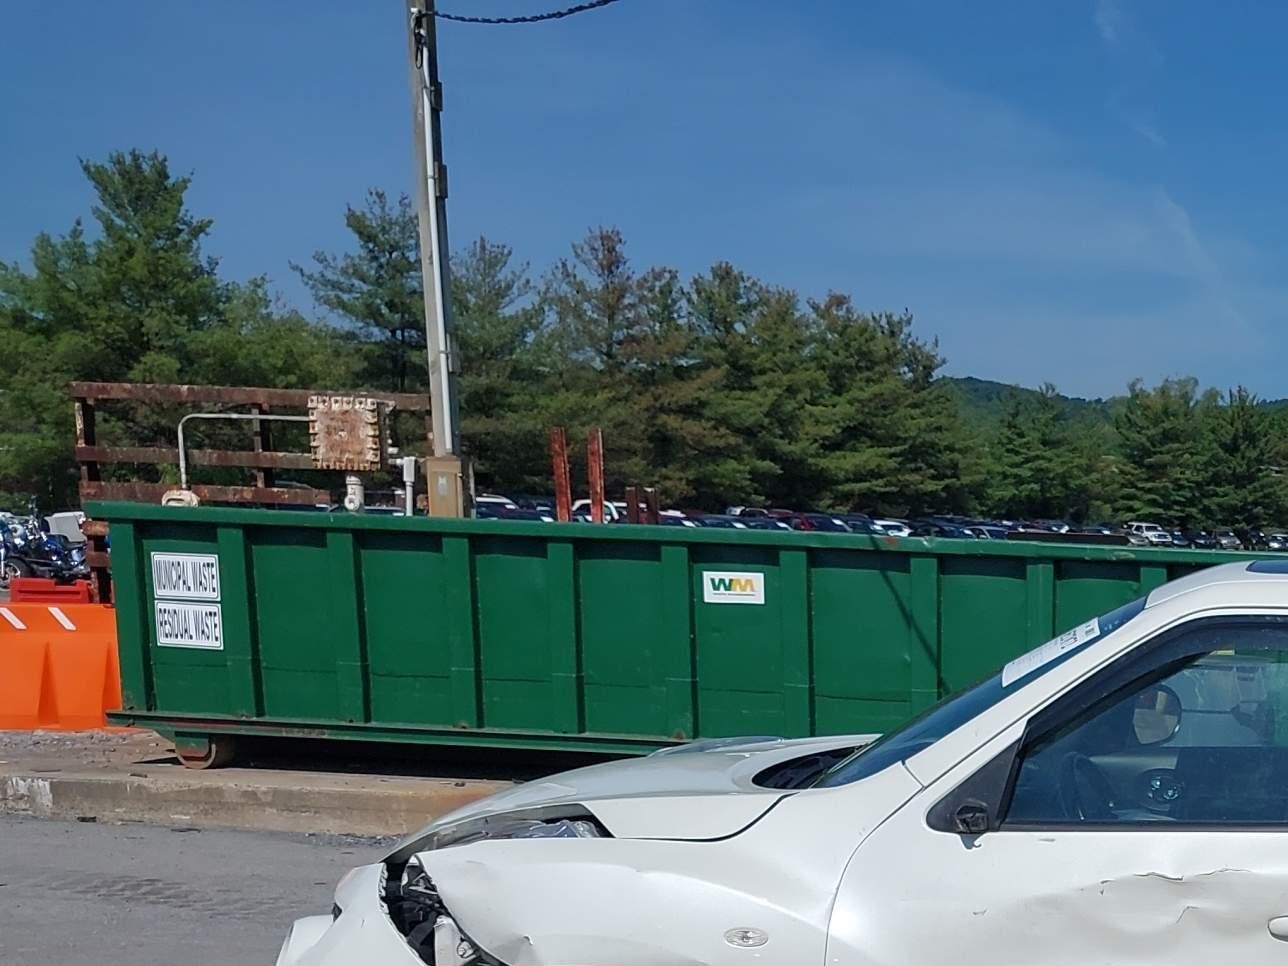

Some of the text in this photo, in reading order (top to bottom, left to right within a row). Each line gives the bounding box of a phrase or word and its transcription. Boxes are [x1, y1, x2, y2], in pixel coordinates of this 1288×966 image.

[155, 559, 216, 593] MUNICIPAL WASTE
[710, 577, 756, 592] WM
[159, 607, 219, 642] RESIDUAL WASTE
